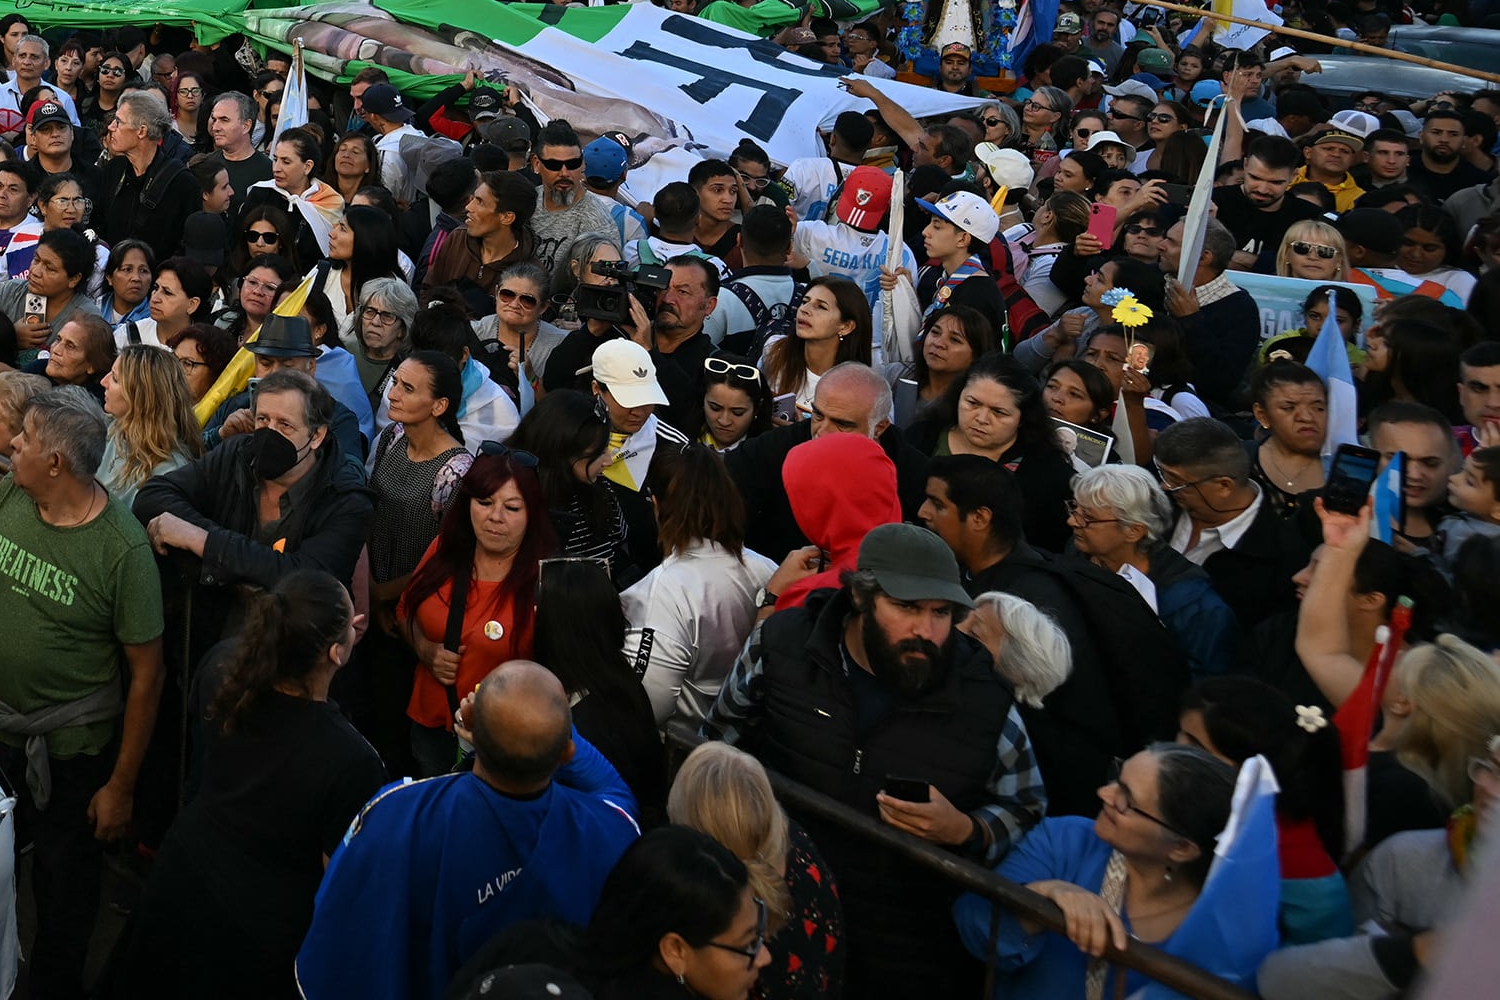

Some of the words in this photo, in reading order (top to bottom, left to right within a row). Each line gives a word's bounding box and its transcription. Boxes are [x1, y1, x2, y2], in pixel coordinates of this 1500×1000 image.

[822, 247, 859, 270] SEBA
[638, 631, 651, 666] NIKE
[478, 882, 495, 904] LA
